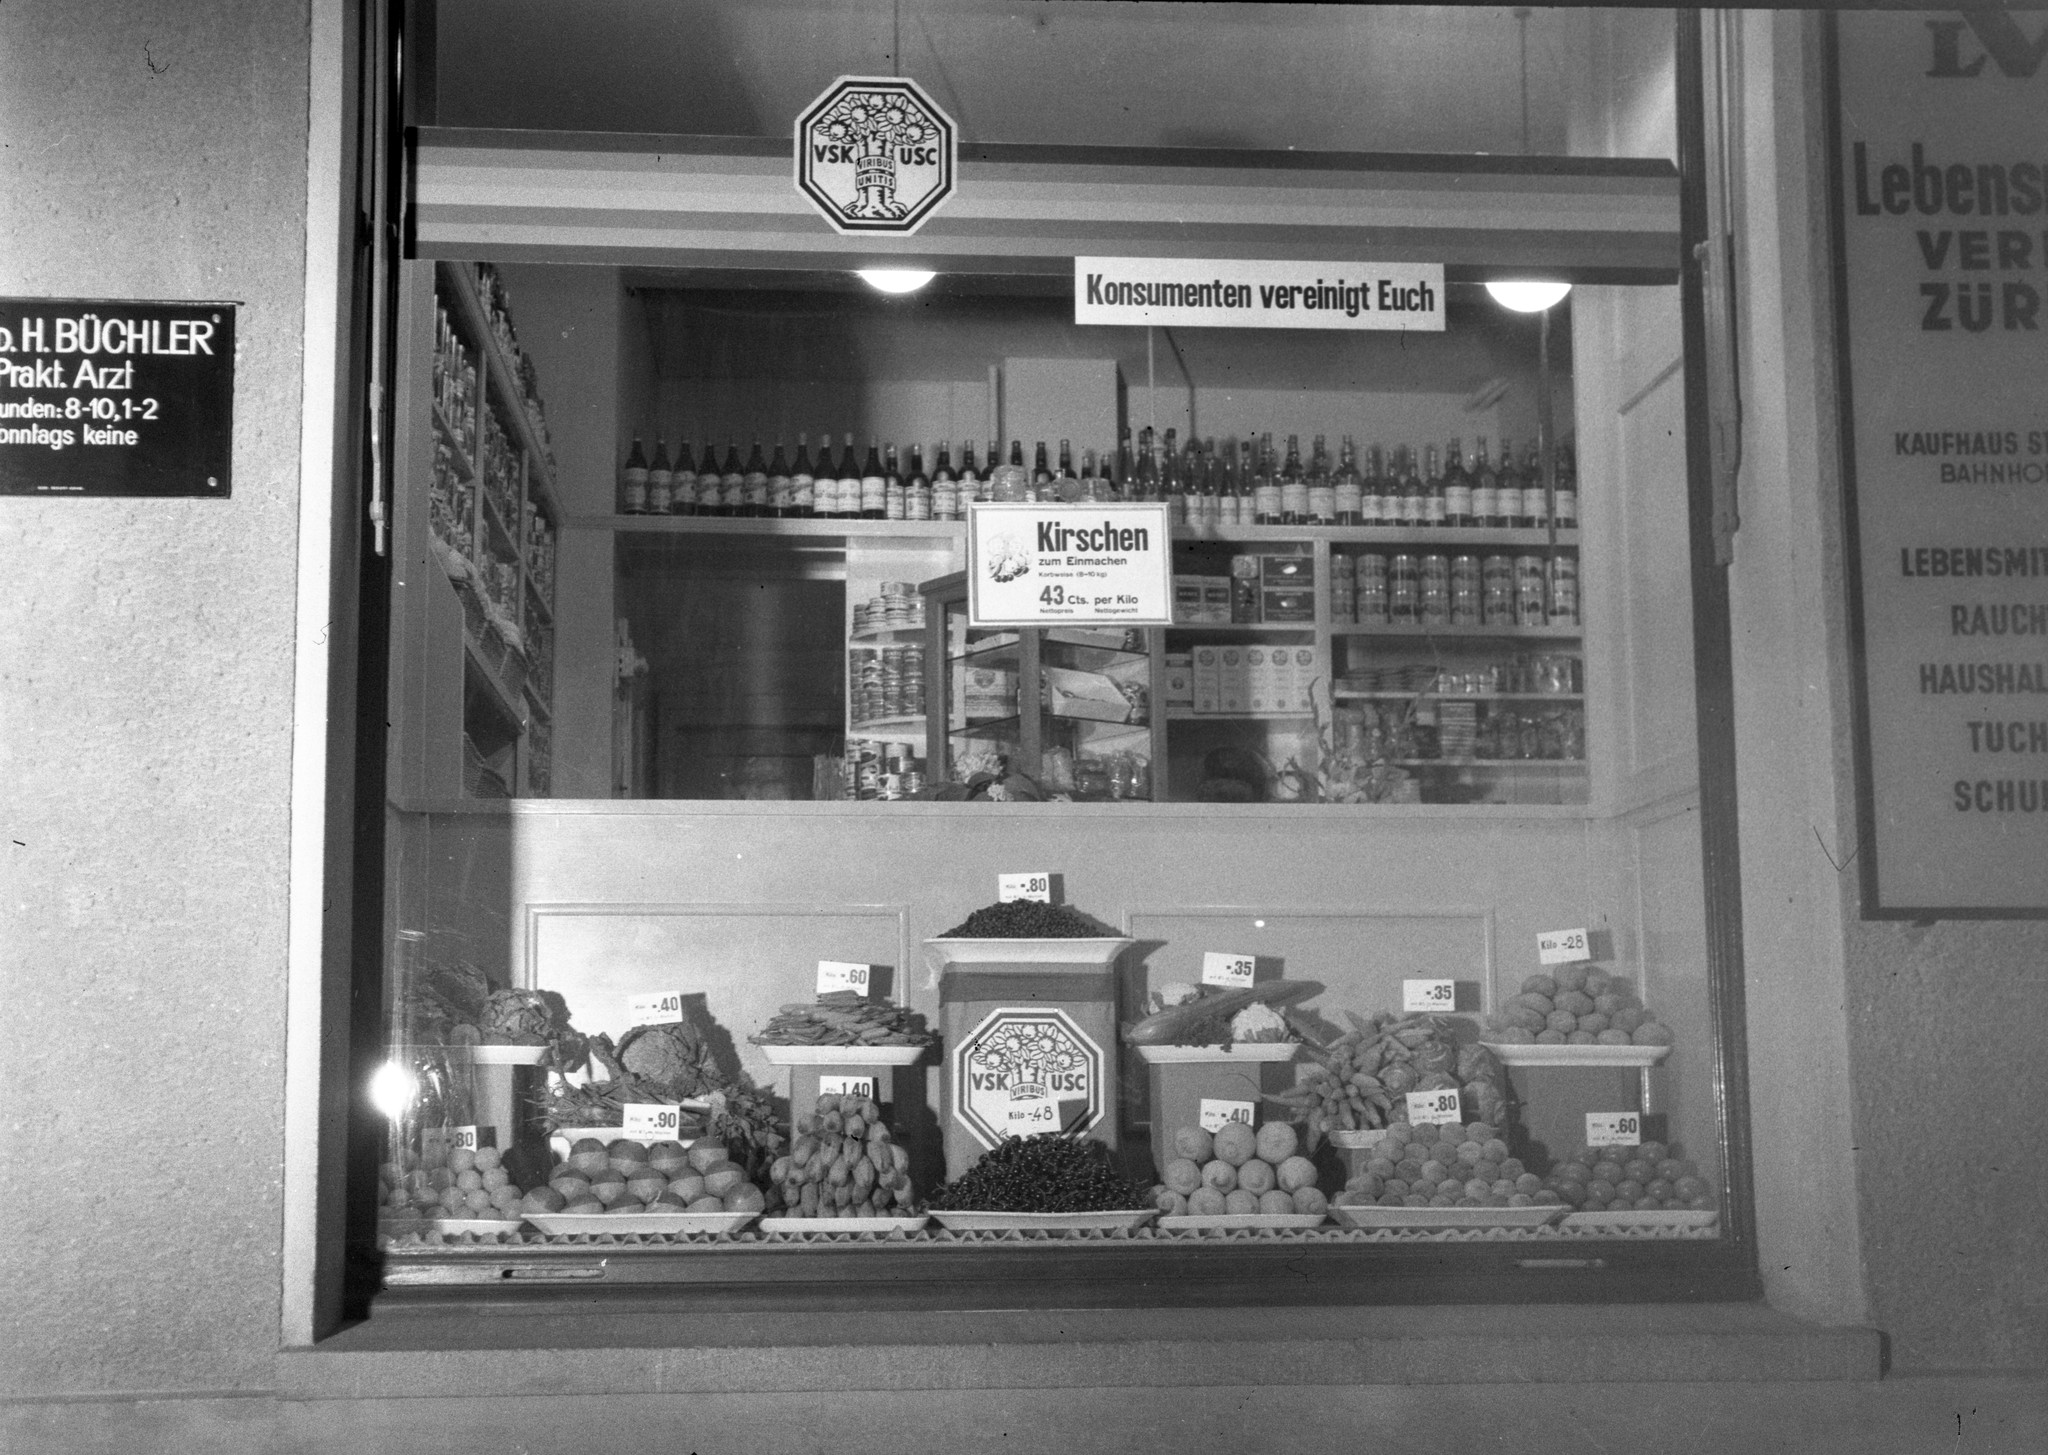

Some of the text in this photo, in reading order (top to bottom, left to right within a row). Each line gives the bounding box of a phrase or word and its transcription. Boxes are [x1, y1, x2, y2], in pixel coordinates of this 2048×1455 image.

[814, 145, 854, 163] VSK
[857, 158, 893, 170] VIRIBUS
[900, 148, 937, 165] USC
[858, 175, 893, 187] UNITIS
[1854, 141, 2048, 216] Lebens
[1917, 230, 2048, 270] VER
[1086, 273, 1434, 318] Konsumenten vereinigt Euch
[1919, 282, 2040, 332] ZÜR
[56, 314, 214, 355] BÜCHLER
[0, 358, 135, 389] Prakt. Arzt
[84, 424, 139, 445] keine
[1895, 432, 2018, 456] KAUFHAUS
[1941, 462, 2048, 484] BAHNHO
[1037, 521, 1149, 552] Kirschen
[1038, 556, 1127, 566] zum Einmachen
[1039, 585, 1139, 606] 43 Cts. per Kilo
[972, 1073, 1009, 1091] VSK
[1012, 1084, 1045, 1096] VIRIBUS
[1051, 1074, 1086, 1091] USC
[1008, 1111, 1025, 1120] Kilo
